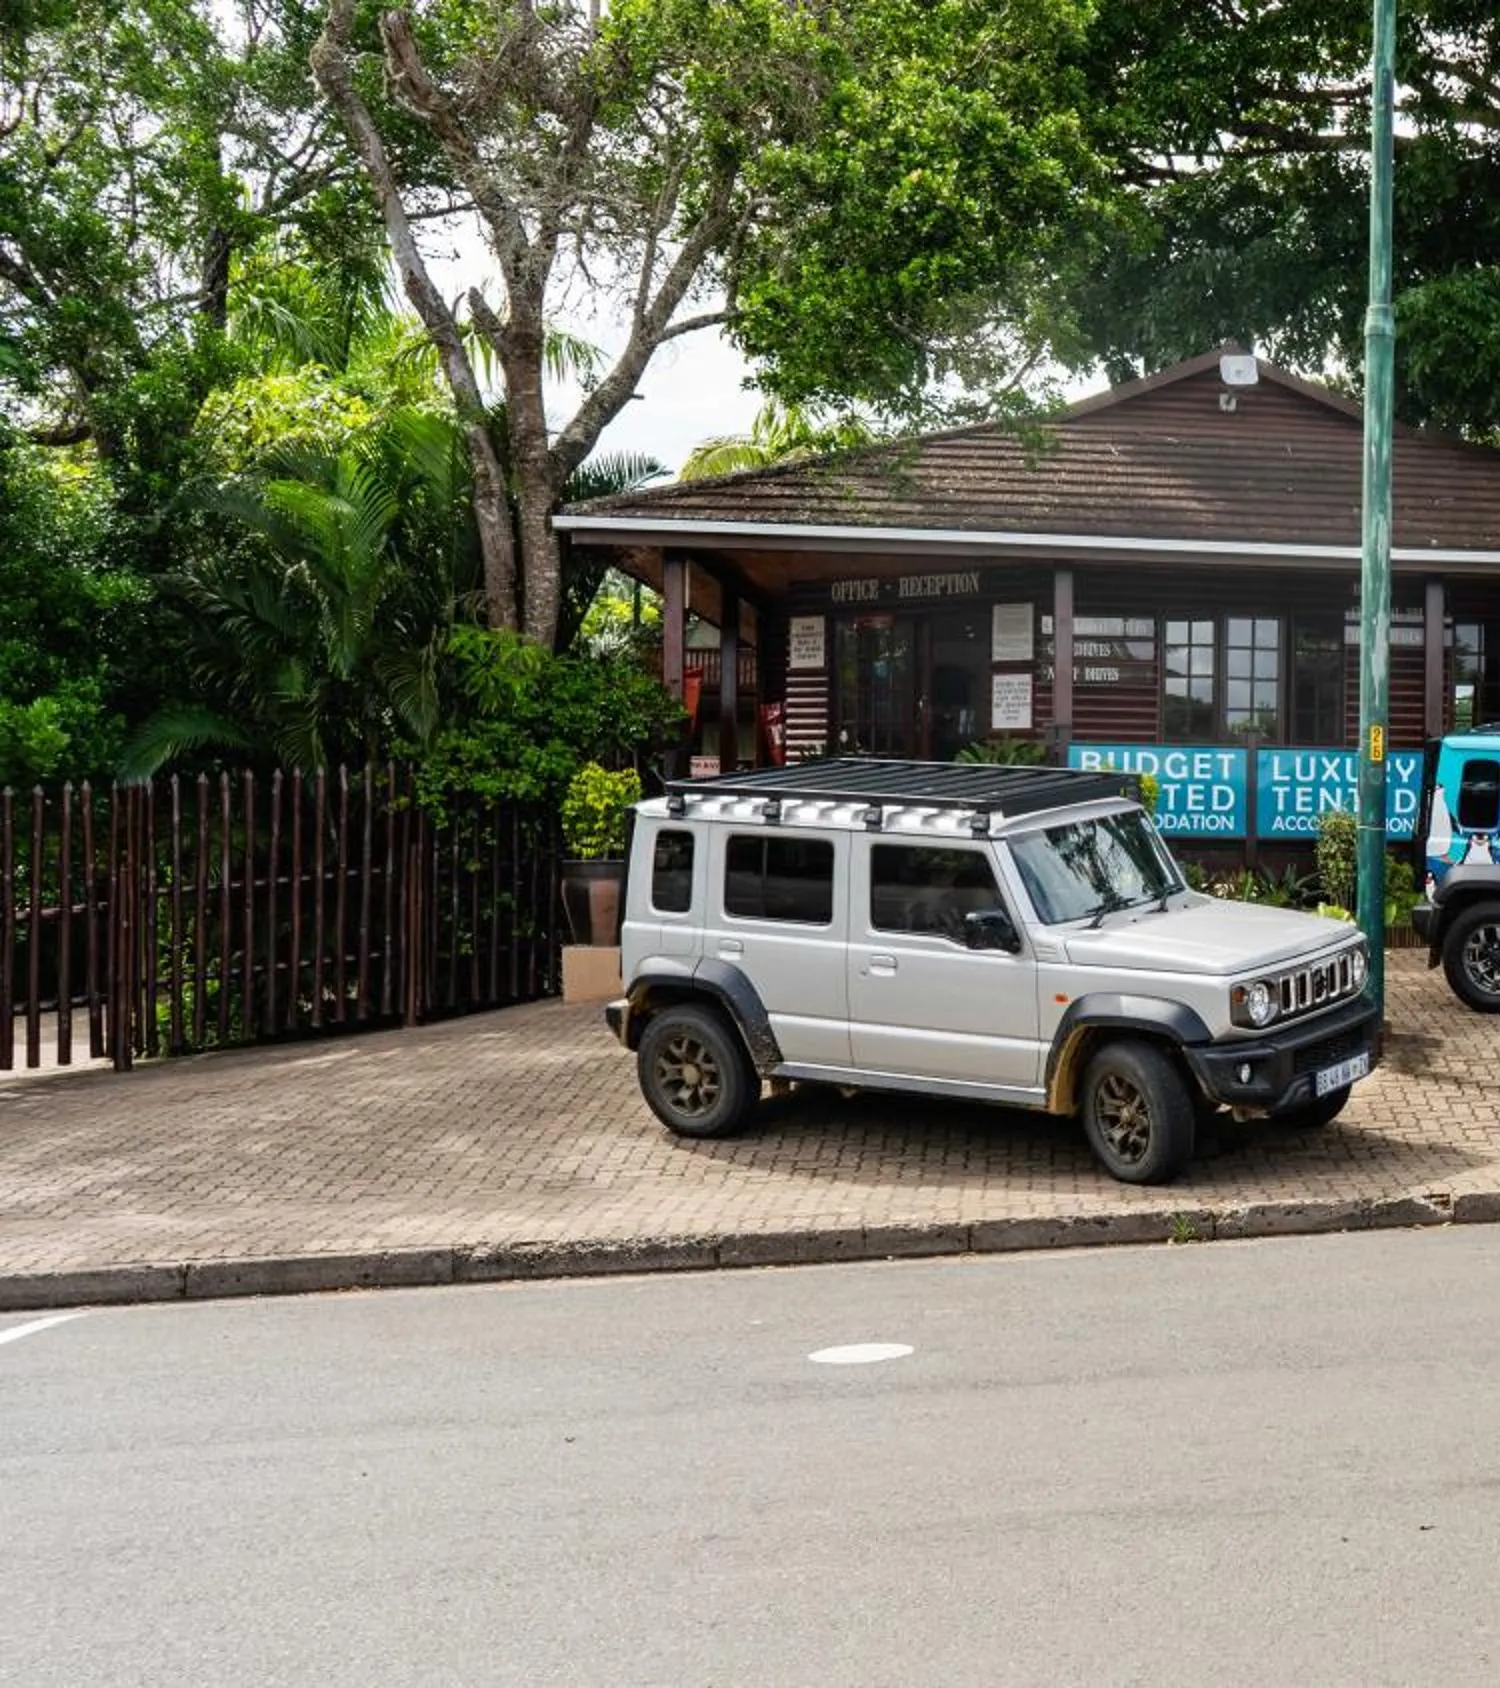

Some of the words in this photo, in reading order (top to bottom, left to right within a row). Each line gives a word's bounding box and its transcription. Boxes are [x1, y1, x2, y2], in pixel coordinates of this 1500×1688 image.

[831, 579, 879, 603] OFFICE
[899, 572, 980, 598] RECEPTION
[1080, 751, 1236, 780] BUDGET
[1272, 756, 1416, 784] LUXUY
[1162, 783, 1236, 812] TED
[1271, 786, 1417, 814] TENTD
[1153, 813, 1235, 831] ODATION
